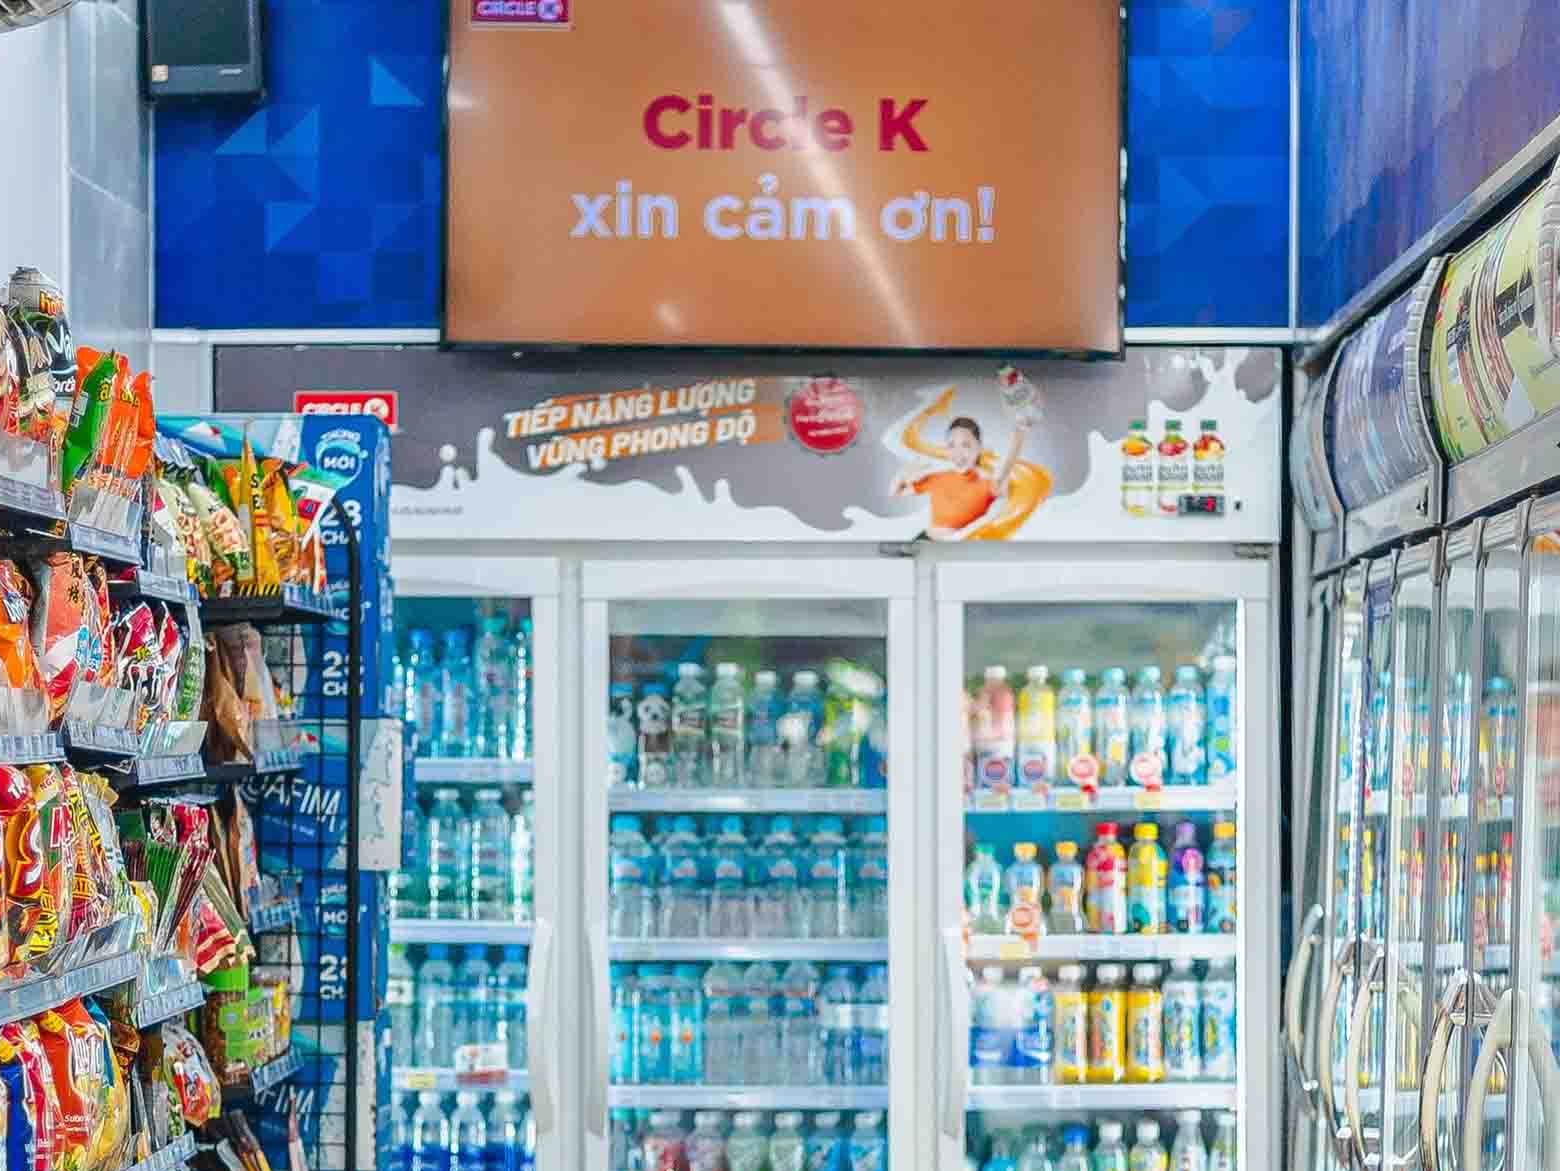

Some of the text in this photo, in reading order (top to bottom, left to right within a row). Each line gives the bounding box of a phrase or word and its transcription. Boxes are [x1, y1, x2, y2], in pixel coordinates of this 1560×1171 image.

[643, 95, 930, 152] Circle K
[569, 173, 997, 242] xin cảm ơn!
[504, 397, 569, 438] TIẾP
[571, 386, 653, 428] NĂNG
[658, 378, 755, 417] LƯỢNG
[610, 420, 713, 458] PHONG
